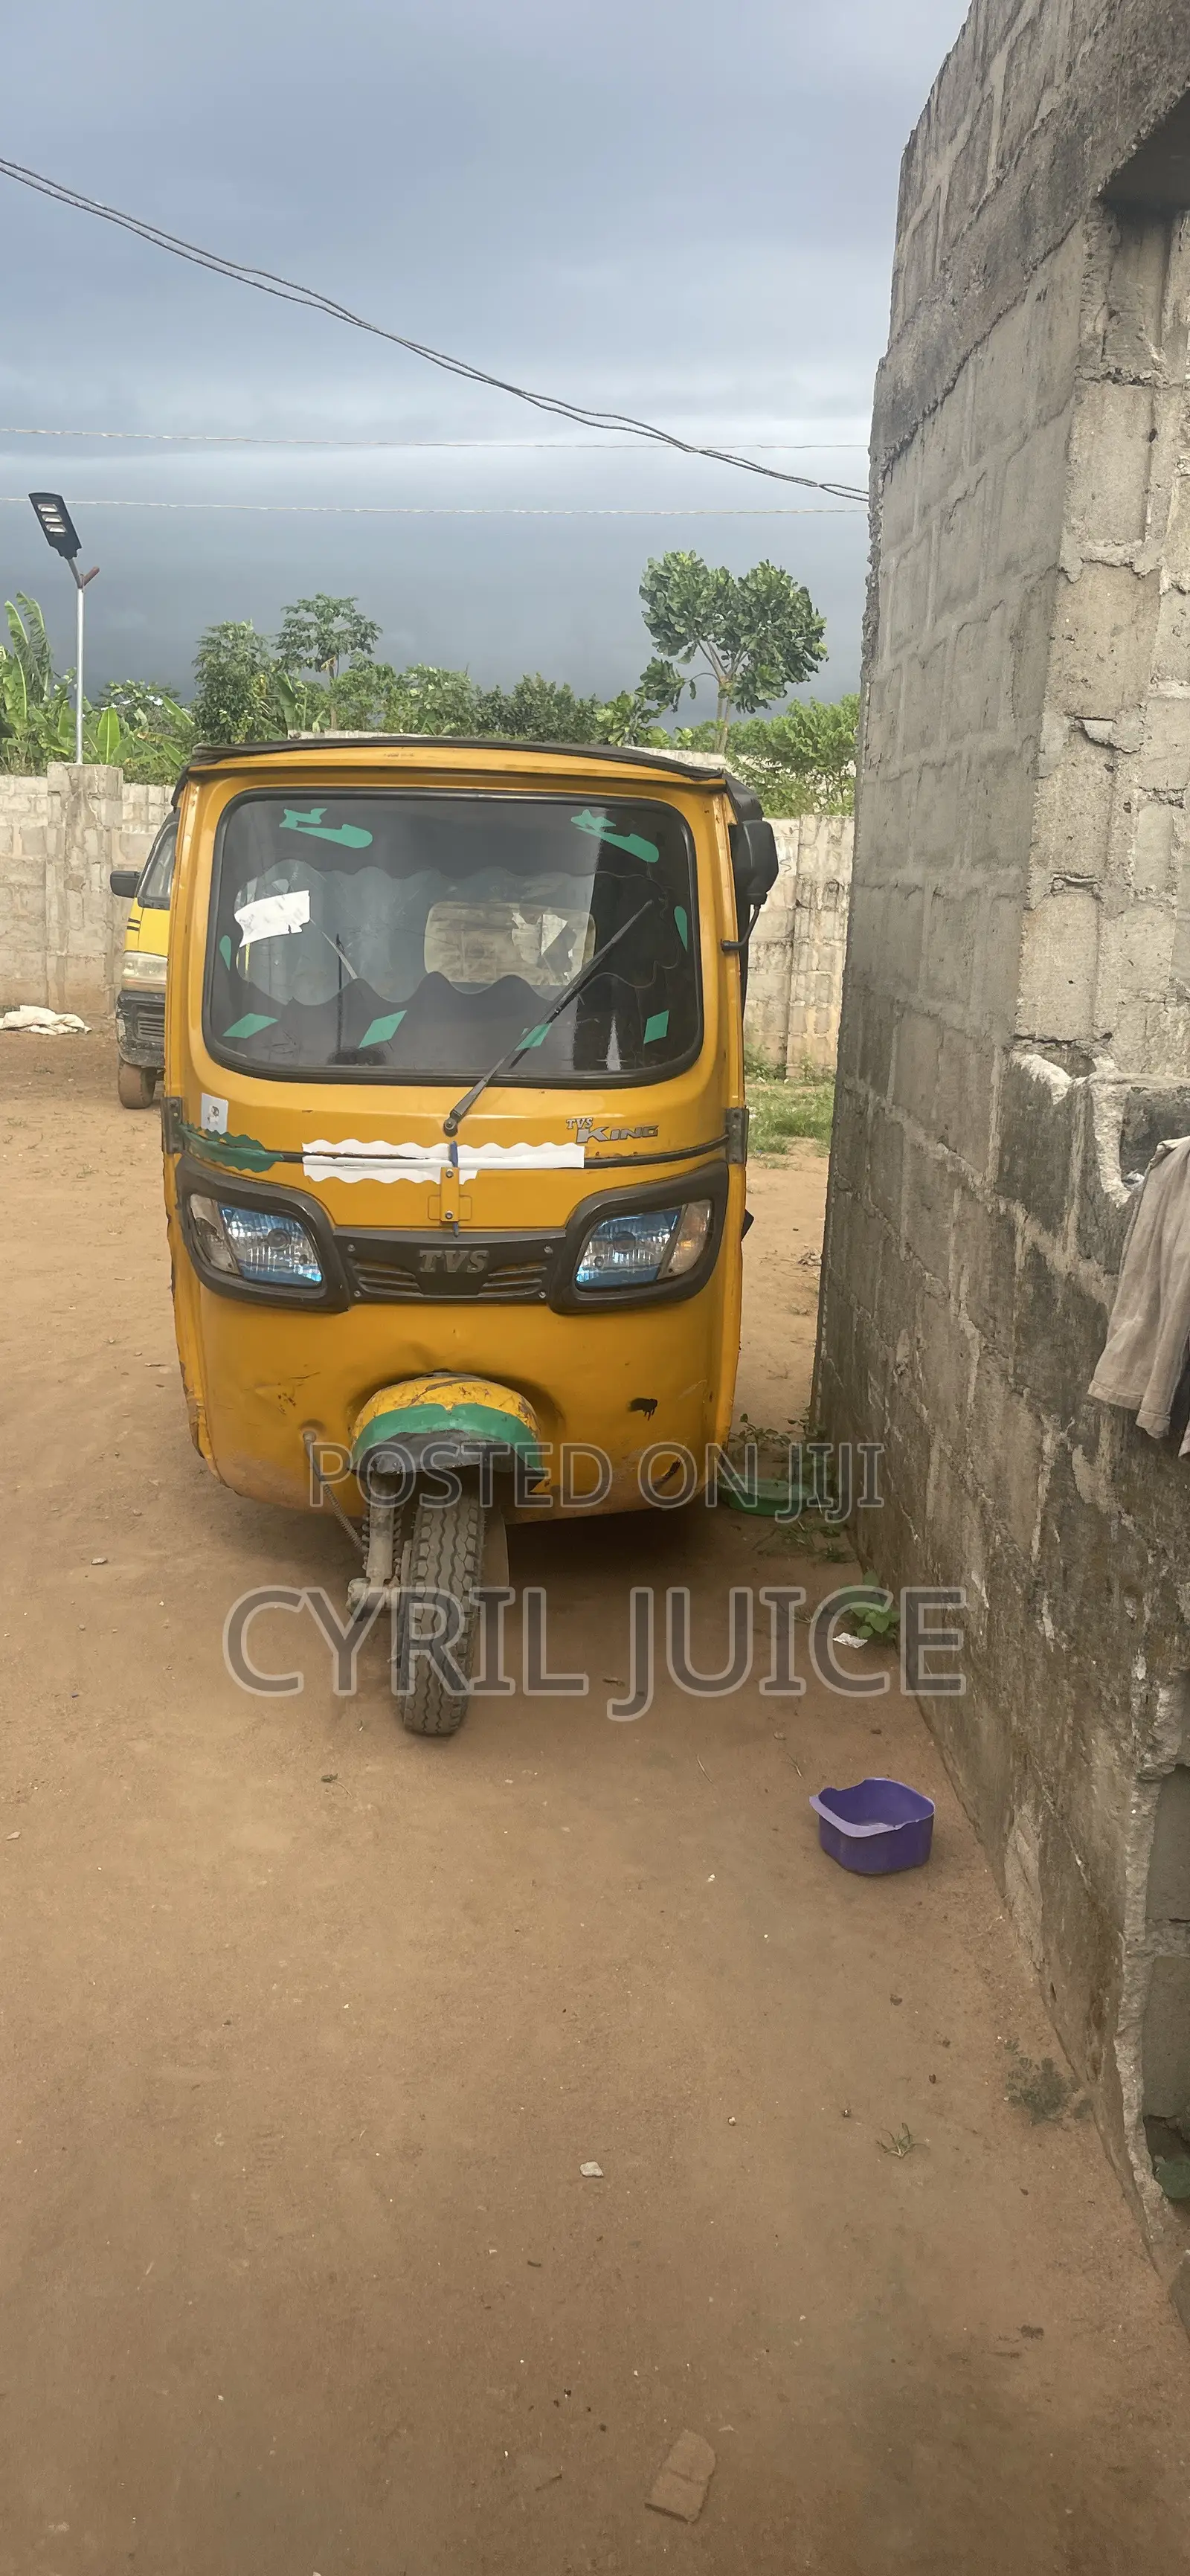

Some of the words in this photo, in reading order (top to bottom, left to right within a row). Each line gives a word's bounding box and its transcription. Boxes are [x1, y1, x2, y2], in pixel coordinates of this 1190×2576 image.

[566, 1117, 594, 1129] TVS
[576, 1125, 659, 1143] KING
[419, 1250, 489, 1273] TVS
